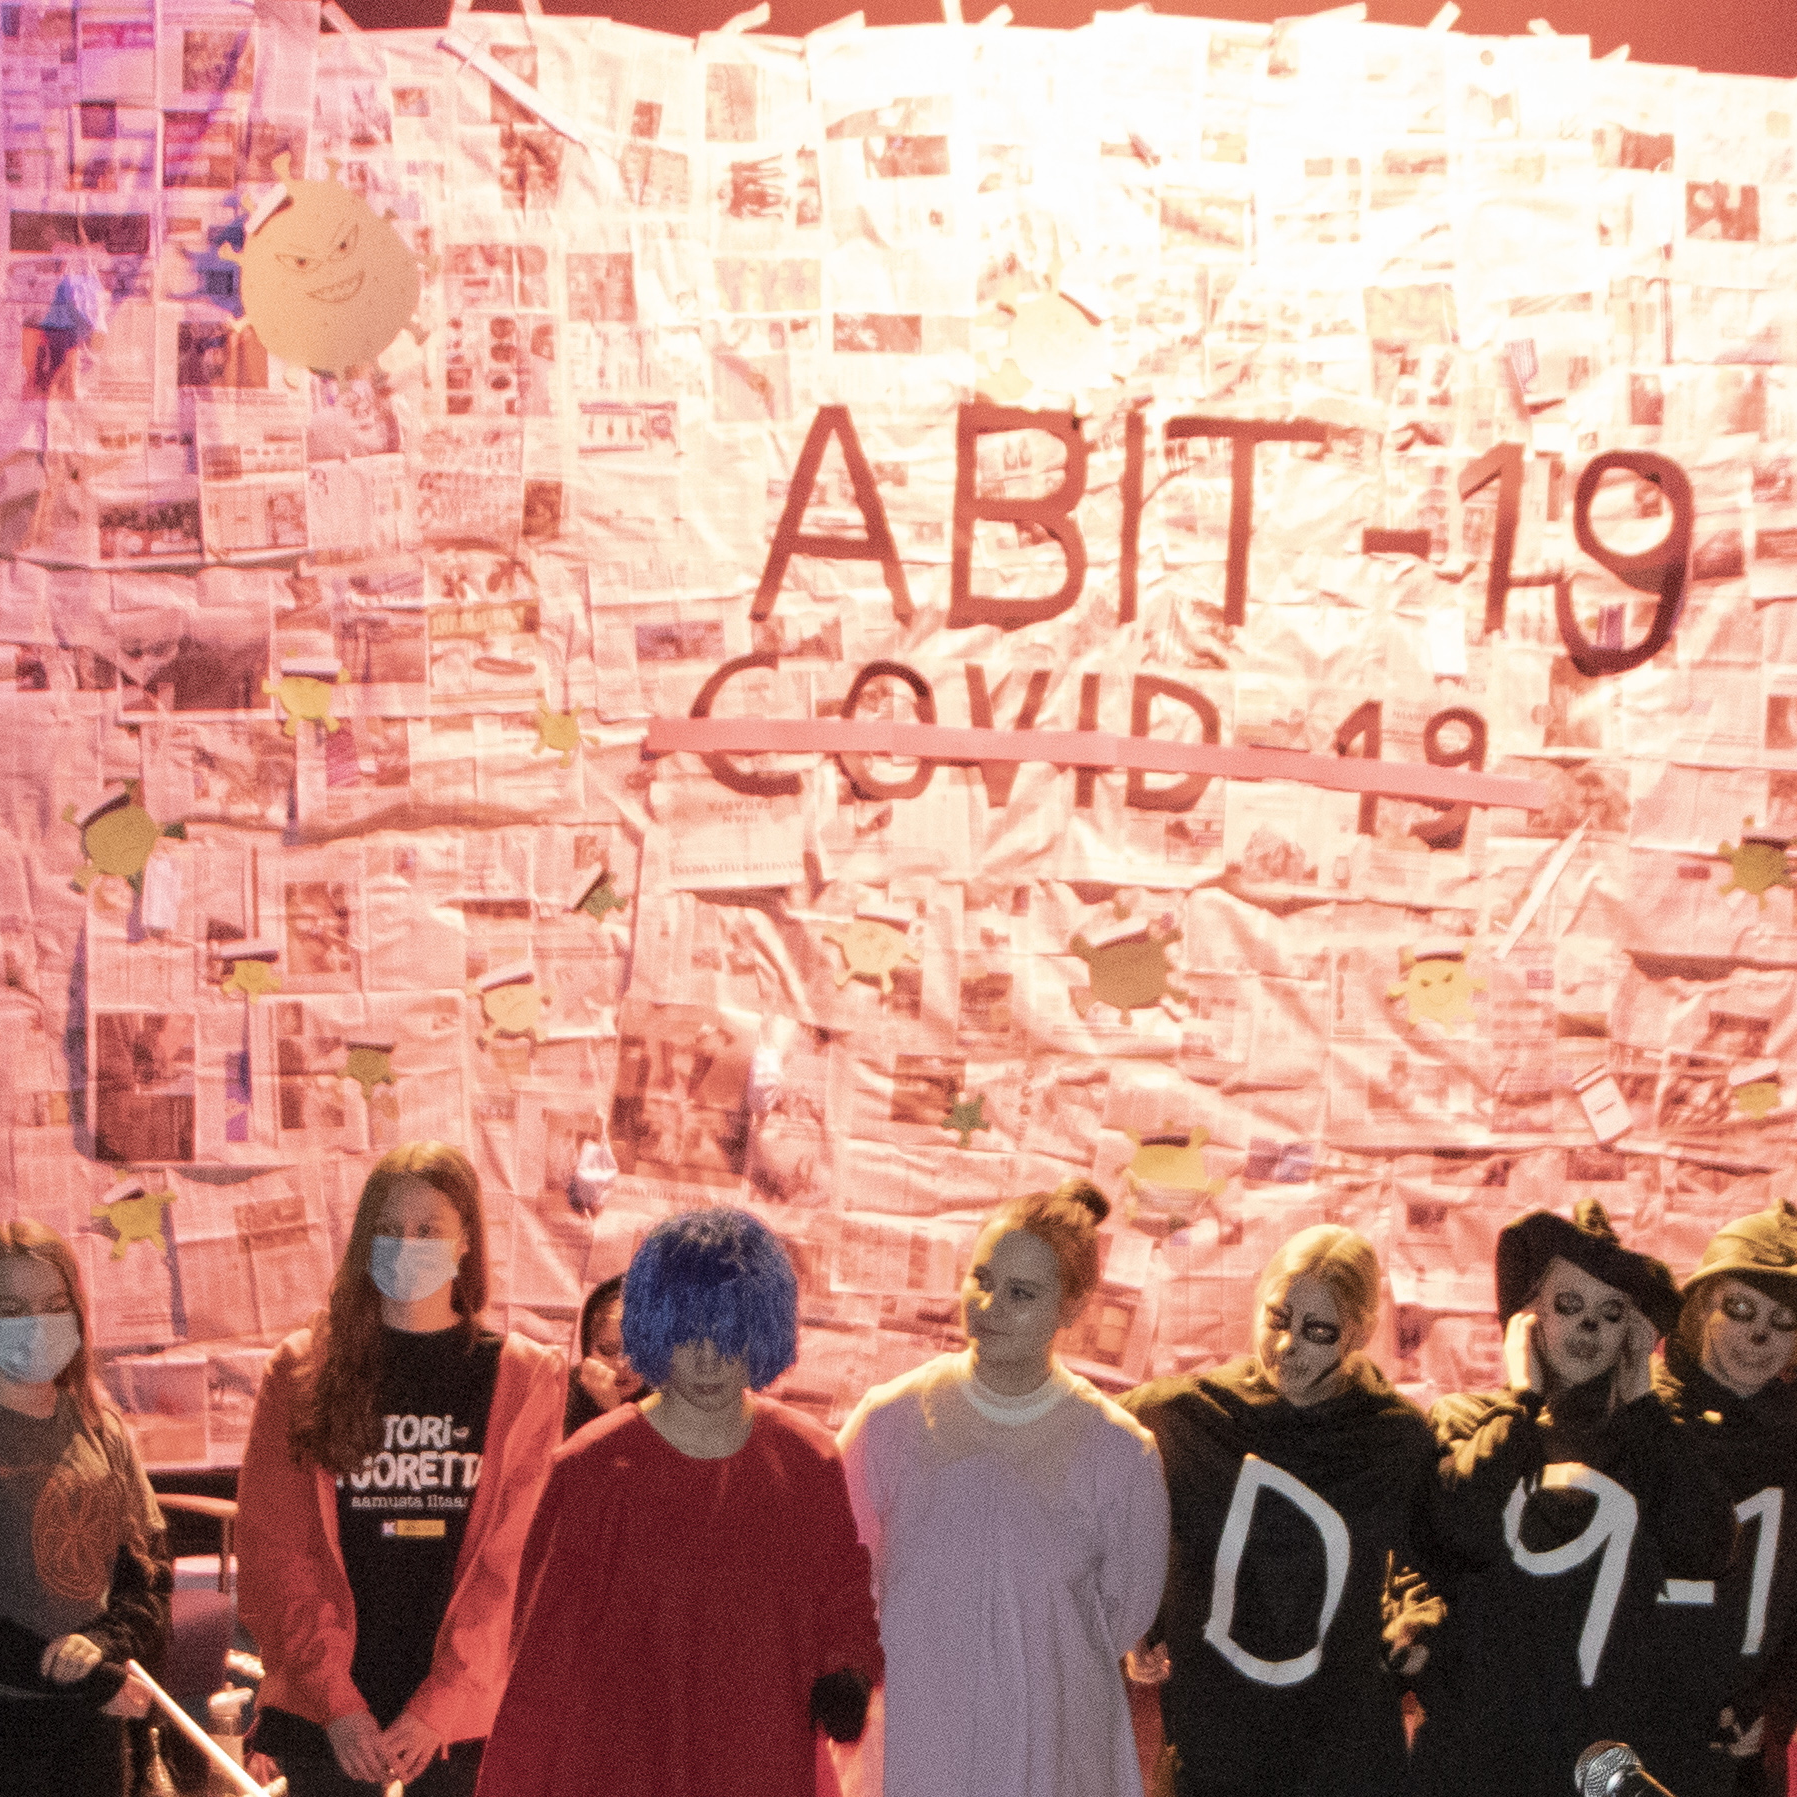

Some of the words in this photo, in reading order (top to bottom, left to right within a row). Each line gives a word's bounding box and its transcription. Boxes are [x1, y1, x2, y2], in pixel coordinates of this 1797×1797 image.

[335, 1451, 482, 1491] UORETT
[351, 1495, 423, 1508] aamusta
[427, 1494, 468, 1508] iltaa
[1205, 1454, 1350, 1686] D
